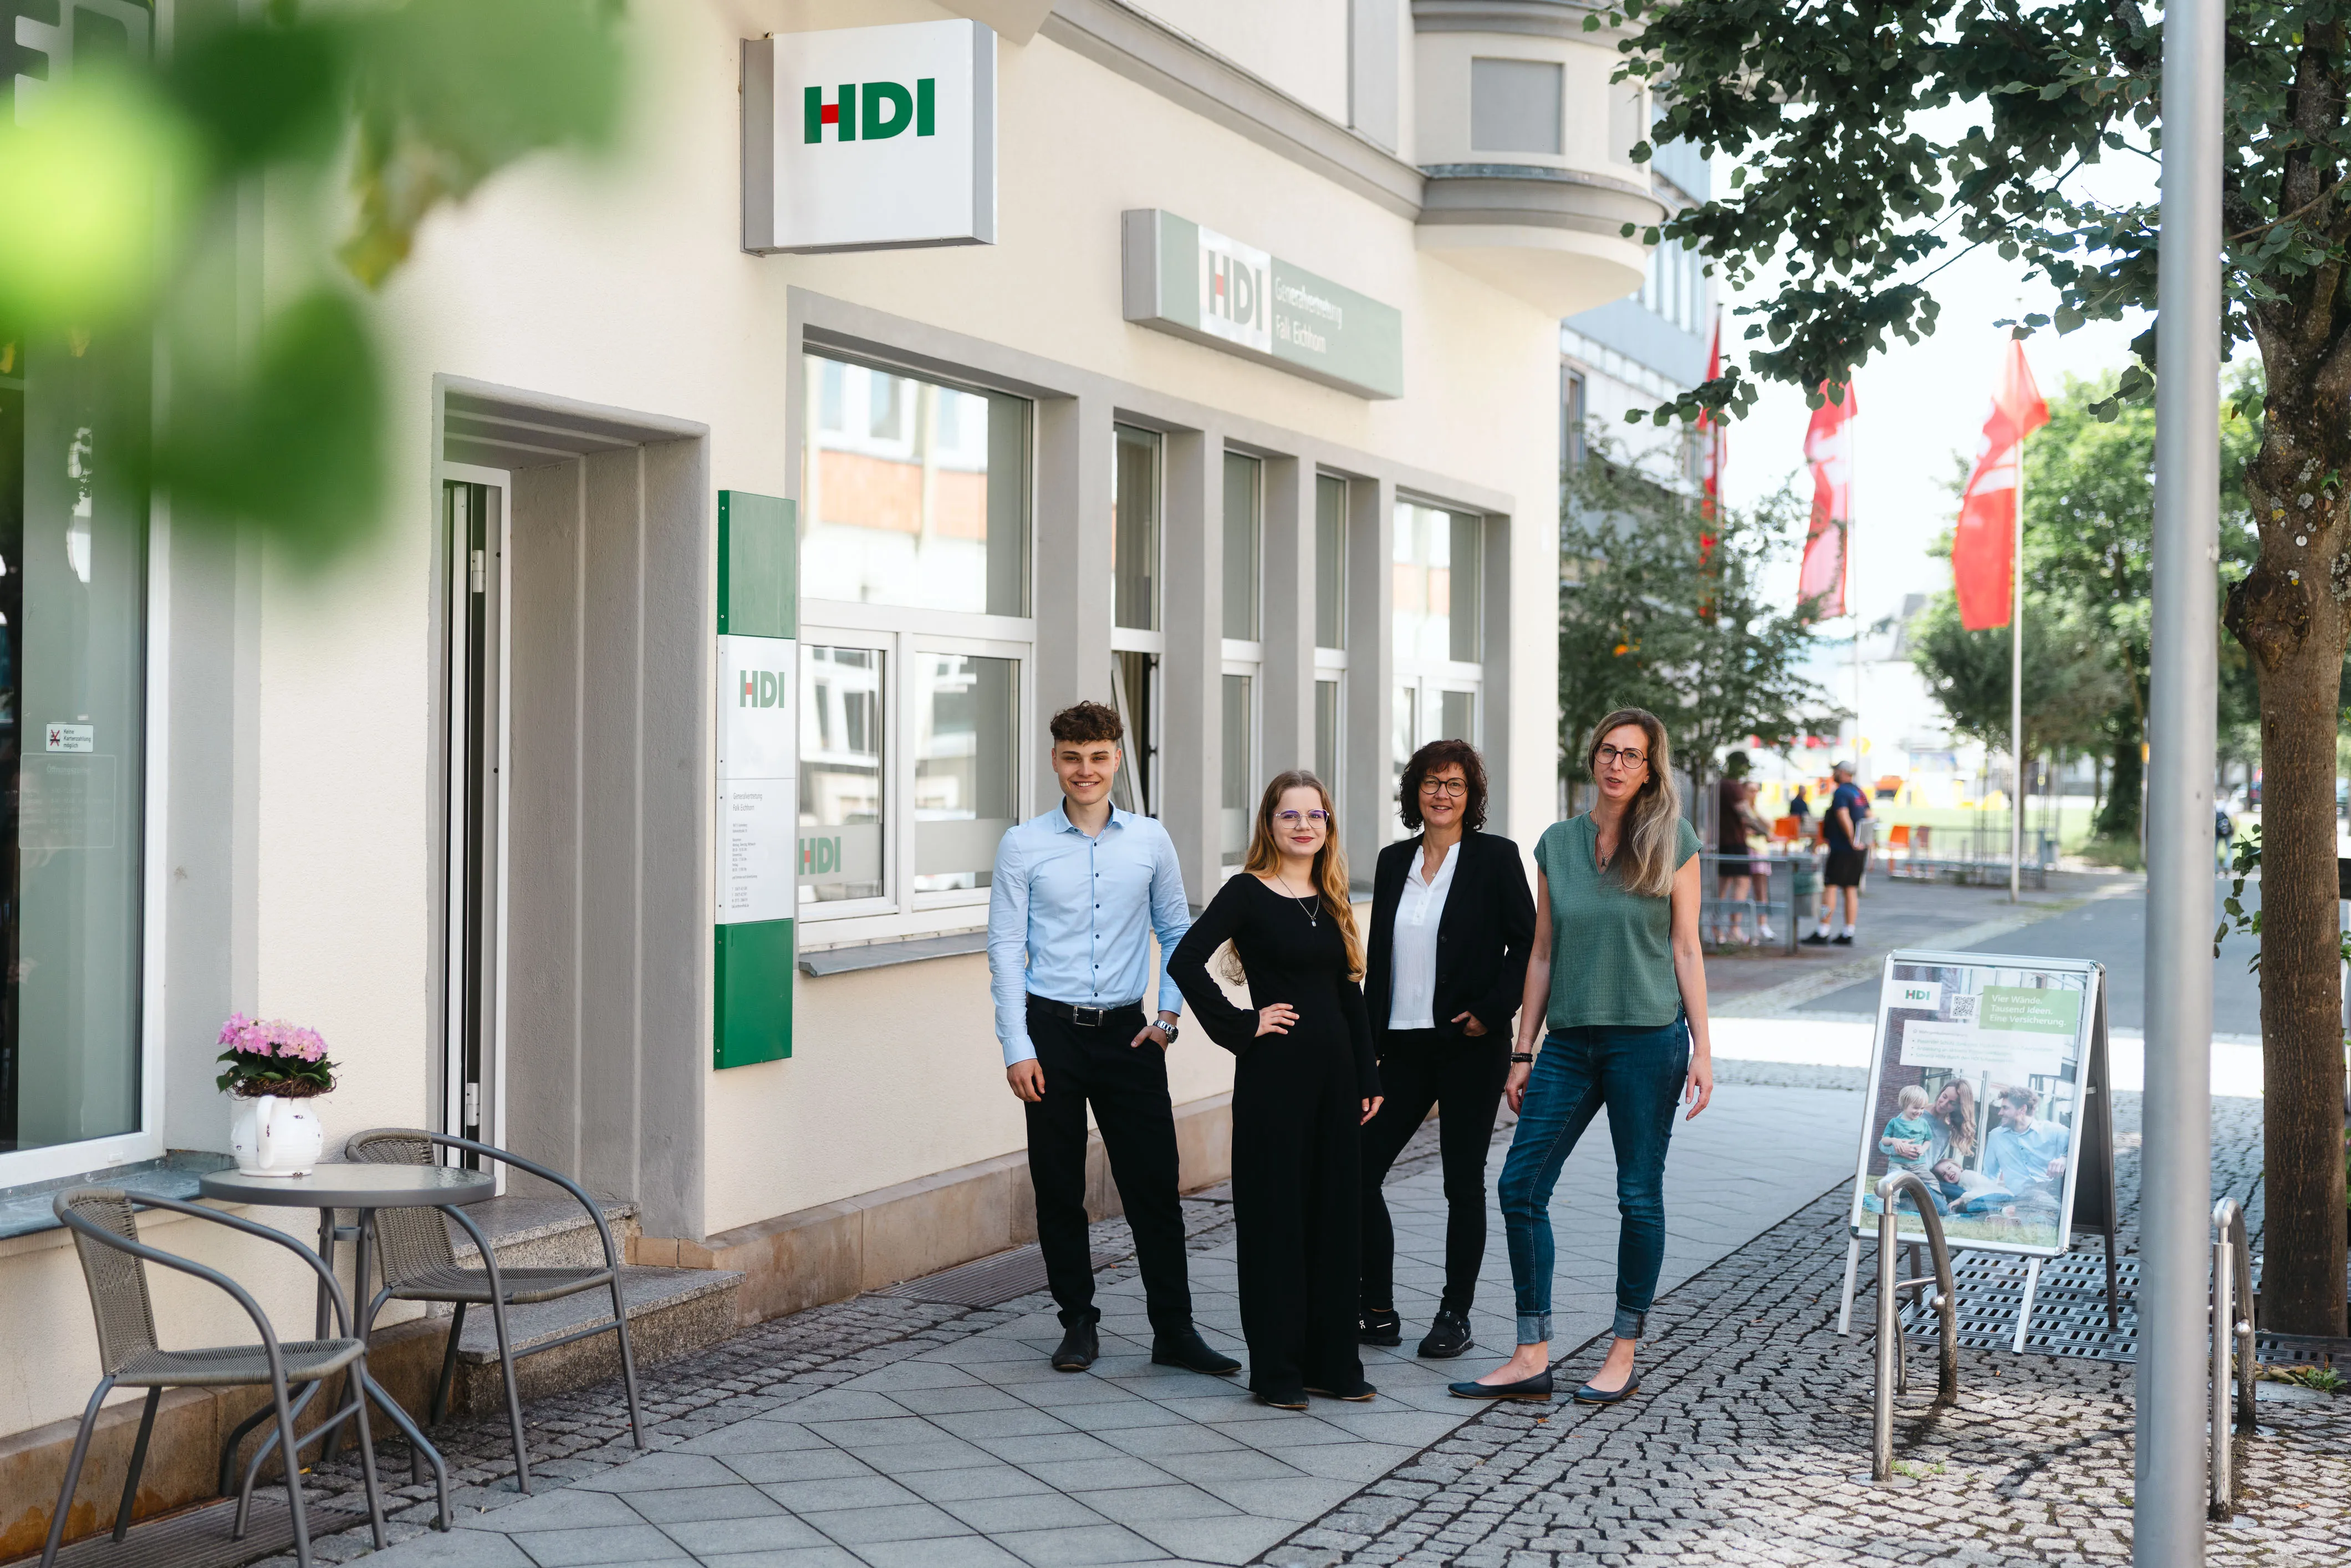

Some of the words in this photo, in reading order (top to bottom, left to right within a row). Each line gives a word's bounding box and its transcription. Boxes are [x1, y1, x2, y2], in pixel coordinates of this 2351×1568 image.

[804, 78, 935, 144] HDI
[1208, 250, 1262, 331] HDI
[1276, 314, 1292, 342] Falk
[740, 670, 785, 708] HDI
[733, 792, 763, 801] Generalvertretung
[799, 836, 841, 875] HDI
[1905, 989, 1930, 1000] HDI
[1992, 994, 2009, 1003] Vier
[2011, 995, 2042, 1005] Wände.
[1991, 1004, 2025, 1014] Tausend
[2027, 1006, 2053, 1015] Ideen.
[1990, 1014, 2007, 1023] Eine
[2009, 1015, 2067, 1028] Versicherung.
